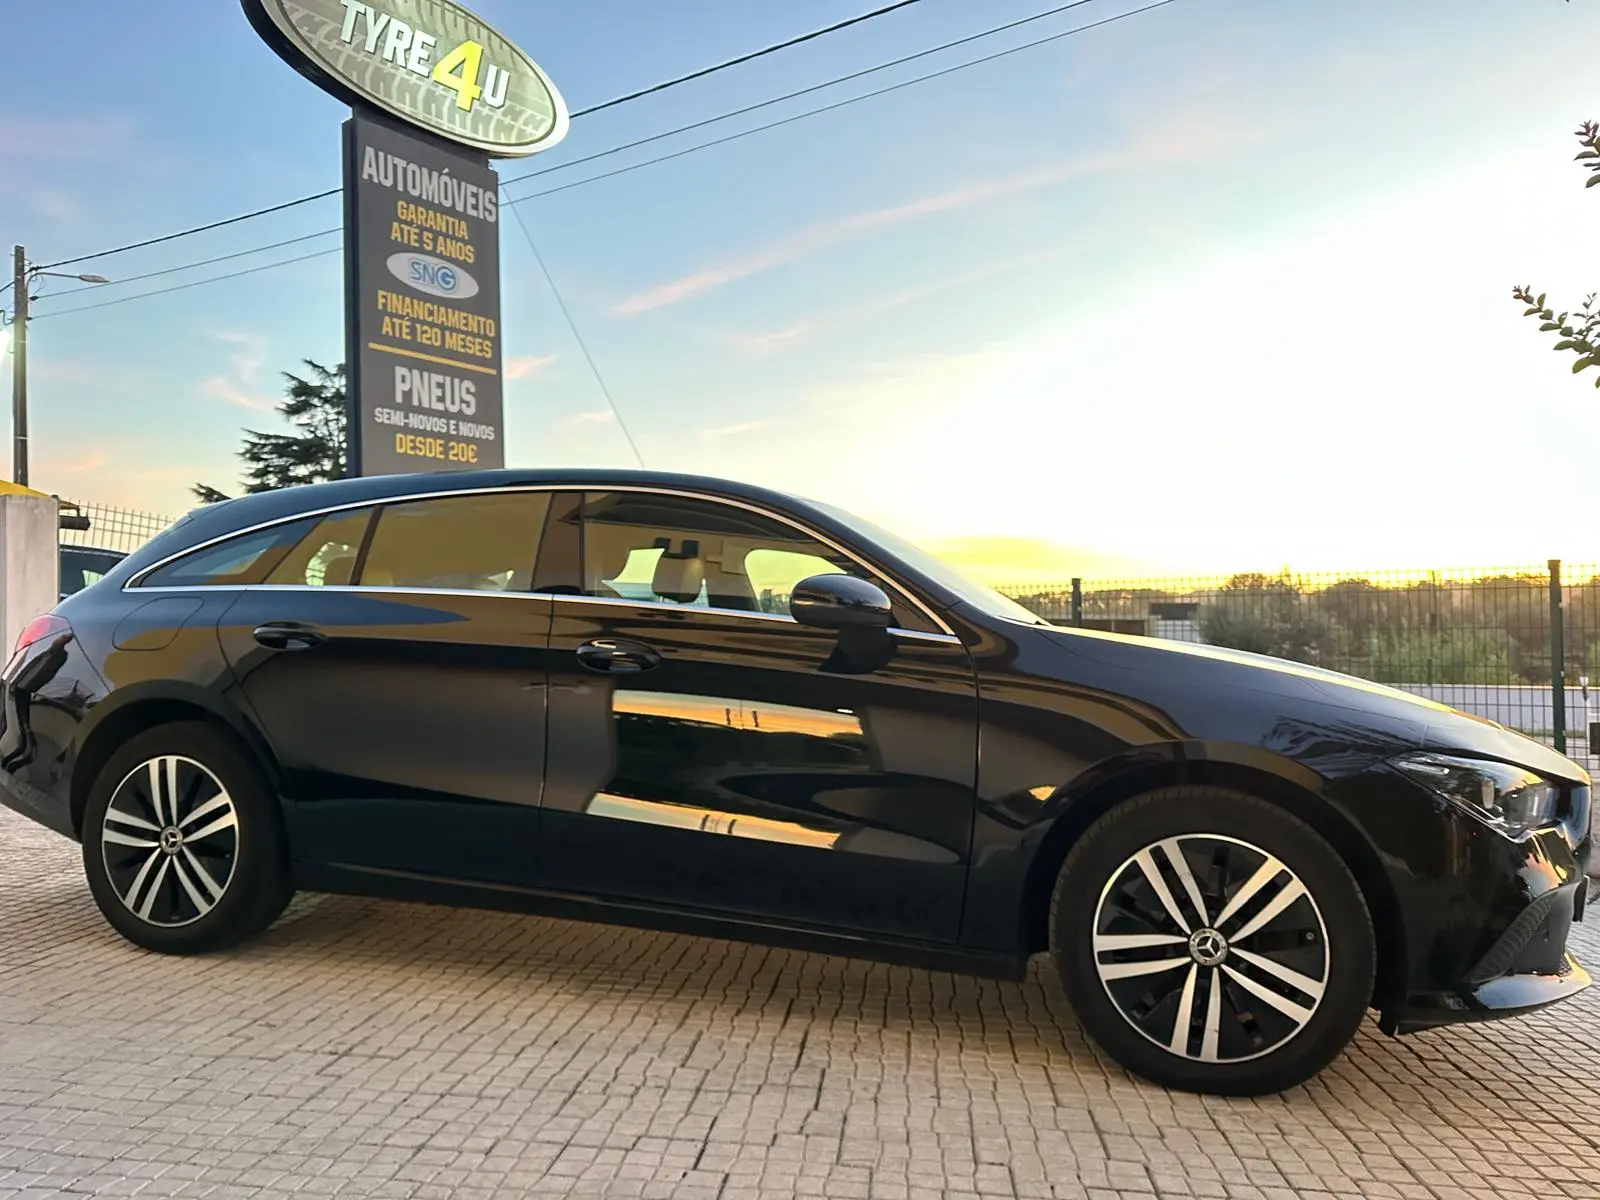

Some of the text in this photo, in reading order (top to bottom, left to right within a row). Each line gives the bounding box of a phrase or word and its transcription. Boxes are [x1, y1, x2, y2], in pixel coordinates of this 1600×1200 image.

[362, 145, 497, 223] AUTOMÓVEIS
[396, 200, 468, 240] GARANTIA
[390, 222, 475, 264] ATÉ 5 ANOS
[410, 260, 457, 291] SNG
[377, 289, 496, 337] FINANCIAMENTO
[381, 316, 493, 359] ATÉ 120 MESES
[394, 366, 476, 416] PNEUS
[374, 407, 495, 440] SEMI-NOVOS E NOVOS
[395, 433, 478, 464] DESDE 20€
